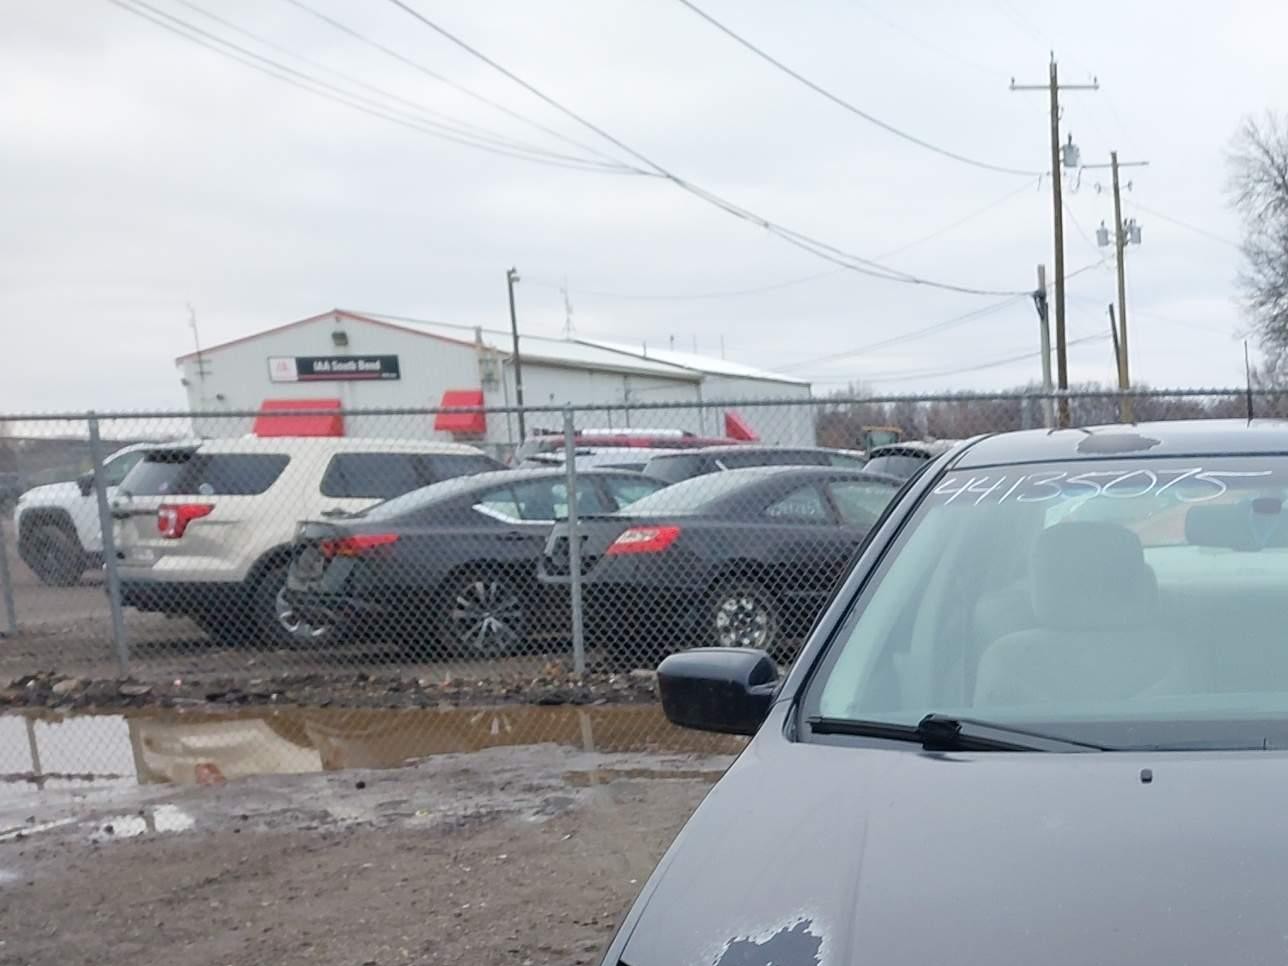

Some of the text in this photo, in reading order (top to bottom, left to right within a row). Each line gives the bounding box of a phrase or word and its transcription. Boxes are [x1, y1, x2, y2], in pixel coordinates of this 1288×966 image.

[331, 360, 357, 371] South
[358, 360, 381, 370] Bend
[932, 467, 1273, 506] 44135075
